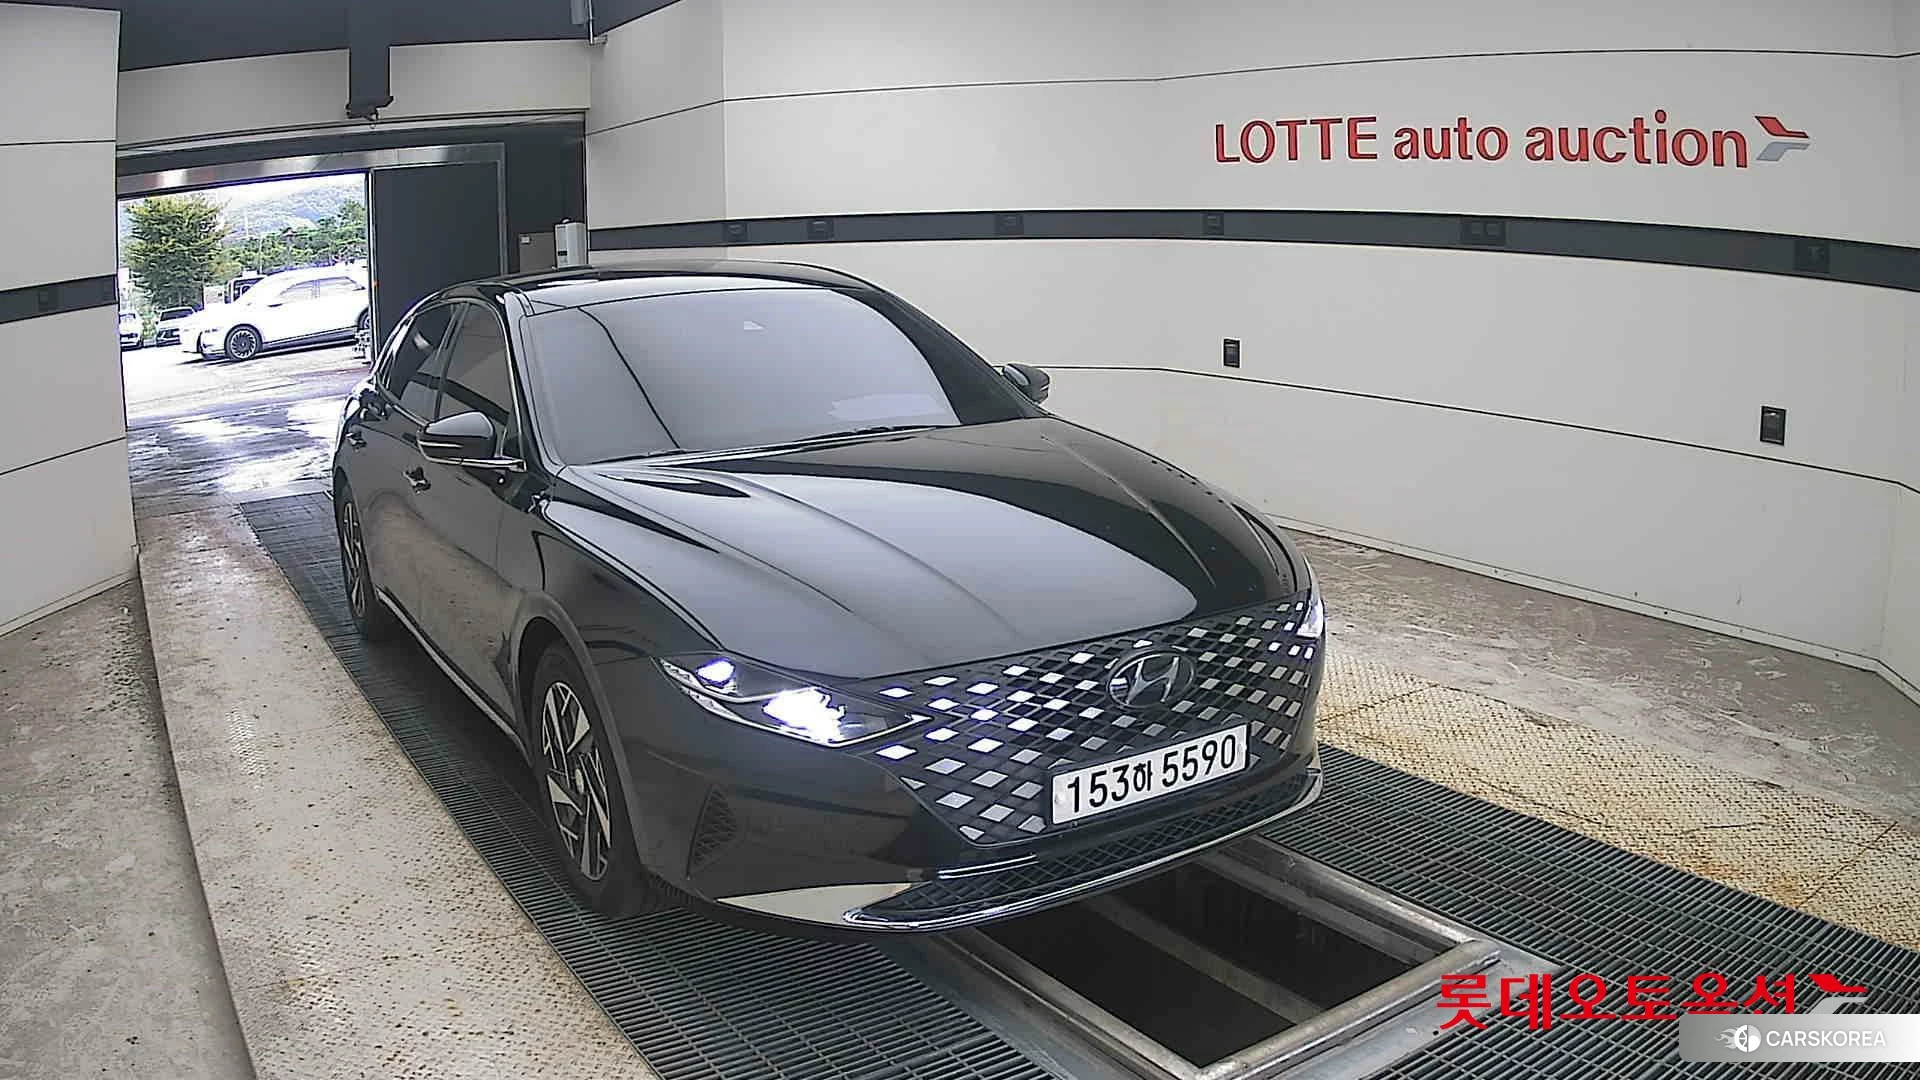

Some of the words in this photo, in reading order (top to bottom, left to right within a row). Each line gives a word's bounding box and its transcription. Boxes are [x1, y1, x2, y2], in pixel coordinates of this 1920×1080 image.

[1215, 116, 1377, 163] LOTTE
[1393, 116, 1509, 162] auto
[1524, 110, 1749, 168] auction
[1067, 760, 1153, 813] 153하
[1161, 734, 1236, 787] 5590
